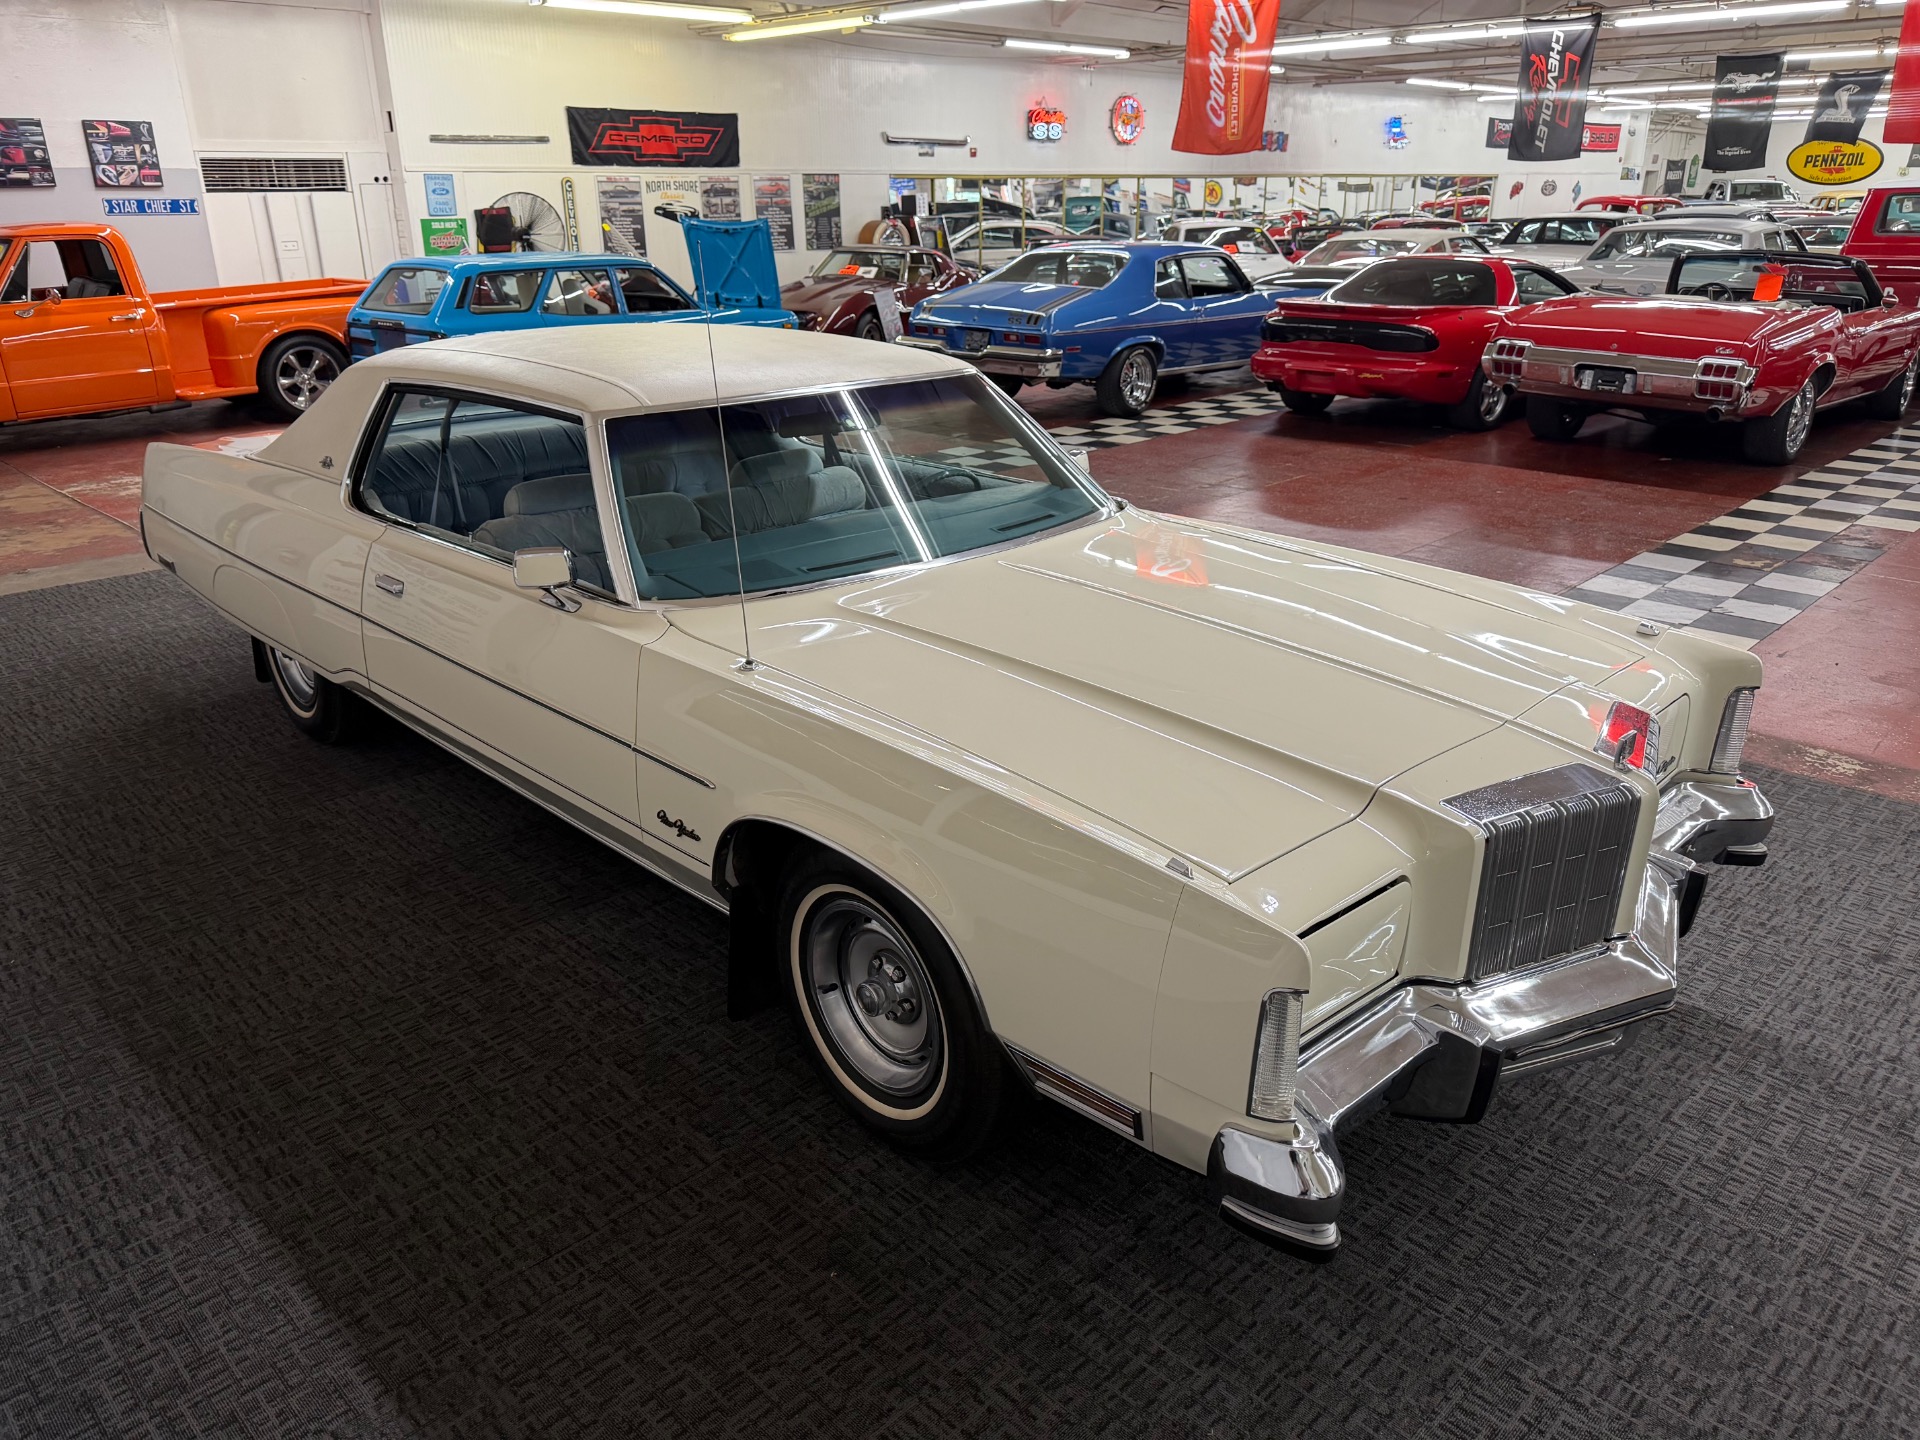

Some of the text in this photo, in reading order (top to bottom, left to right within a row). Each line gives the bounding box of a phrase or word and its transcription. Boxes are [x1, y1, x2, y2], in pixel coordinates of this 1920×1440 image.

[1230, 47, 1240, 135] BY CHEVROLET
[1534, 29, 1565, 153] CHEVROLET
[608, 133, 705, 144] CAMARO
[1032, 122, 1062, 140] SS
[1590, 131, 1618, 144] SHELBY
[1803, 152, 1866, 168] PENNZOIL
[645, 180, 699, 194] NORTH SHORE
[111, 200, 192, 213] STAR CHIEF ST
[565, 182, 579, 252] CHEVROLE
